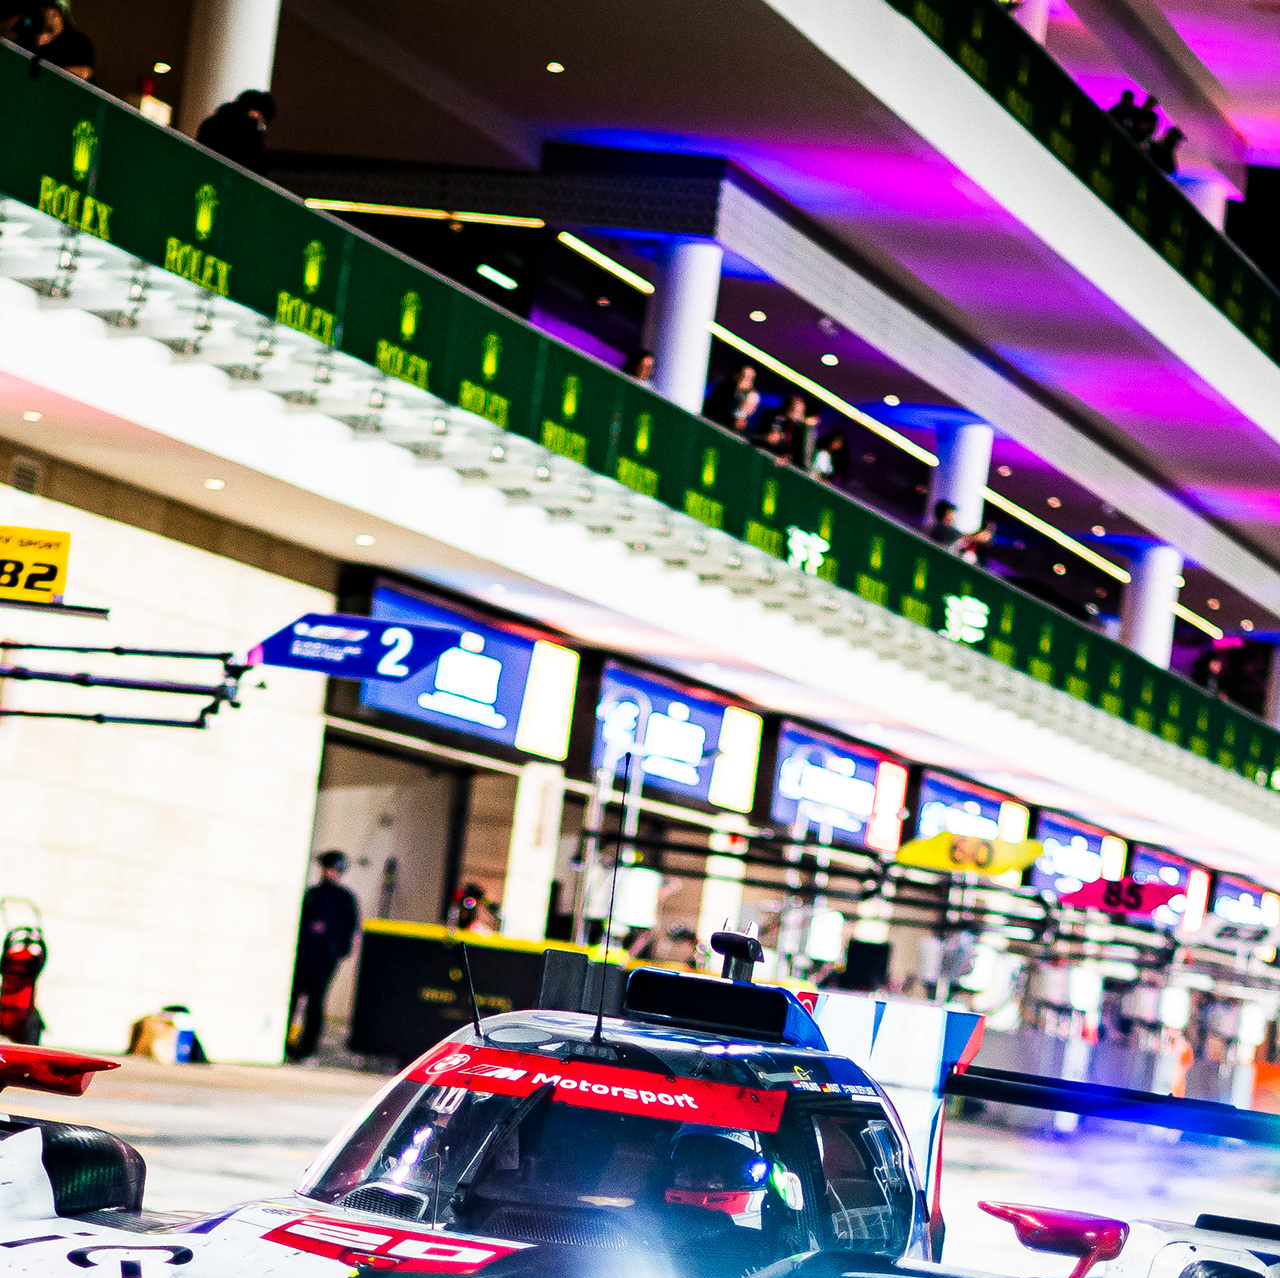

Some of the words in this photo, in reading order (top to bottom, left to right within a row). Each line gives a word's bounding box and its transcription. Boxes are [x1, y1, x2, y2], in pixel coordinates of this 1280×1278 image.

[38, 175, 114, 241] ROLEX
[164, 236, 232, 296] ROLEX
[377, 627, 414, 677] 2
[531, 1072, 699, 1110] Motorsport
